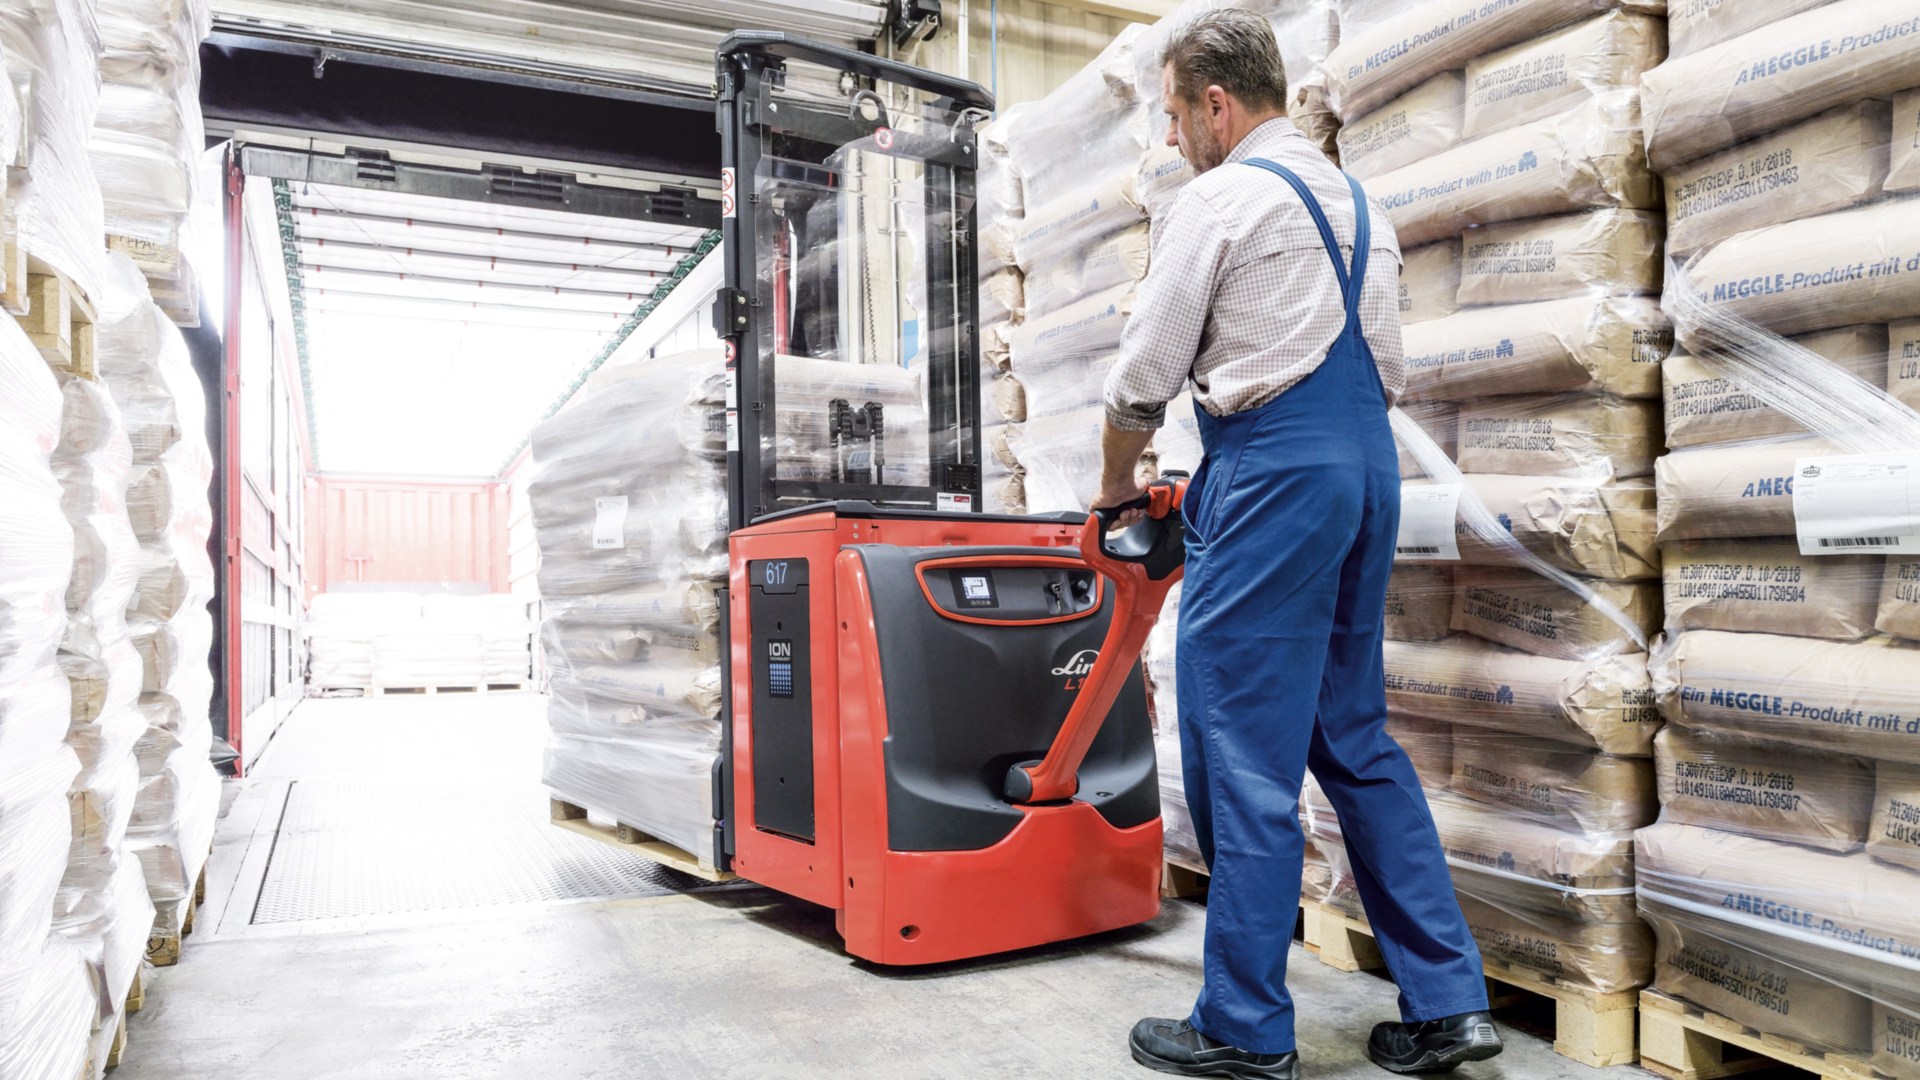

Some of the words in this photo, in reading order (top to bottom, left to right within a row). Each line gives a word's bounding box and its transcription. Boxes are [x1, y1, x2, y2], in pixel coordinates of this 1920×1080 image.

[1348, 65, 1363, 80] Ein
[1364, 18, 1454, 72] MEGGLE-Produkt
[1456, 10, 1477, 29] mit
[1734, 69, 1749, 86] A
[1465, 168, 1492, 188] with
[1495, 163, 1517, 180] the
[1712, 262, 1864, 301] MEGGLE-Produkt
[1868, 256, 1900, 279] mit
[1446, 349, 1466, 364] mit
[1468, 347, 1495, 362] dem
[1741, 482, 1755, 498] A
[765, 561, 788, 585] 617
[769, 642, 791, 657] ION
[1449, 685, 1470, 699] mit
[1469, 687, 1495, 702] dem
[1681, 686, 1705, 703] Ein
[1709, 687, 1864, 726] MEGGLE-Produkt
[1867, 713, 1901, 733] mit
[1721, 893, 1735, 909] A
[1737, 892, 1896, 954] MEGGLE-Product
